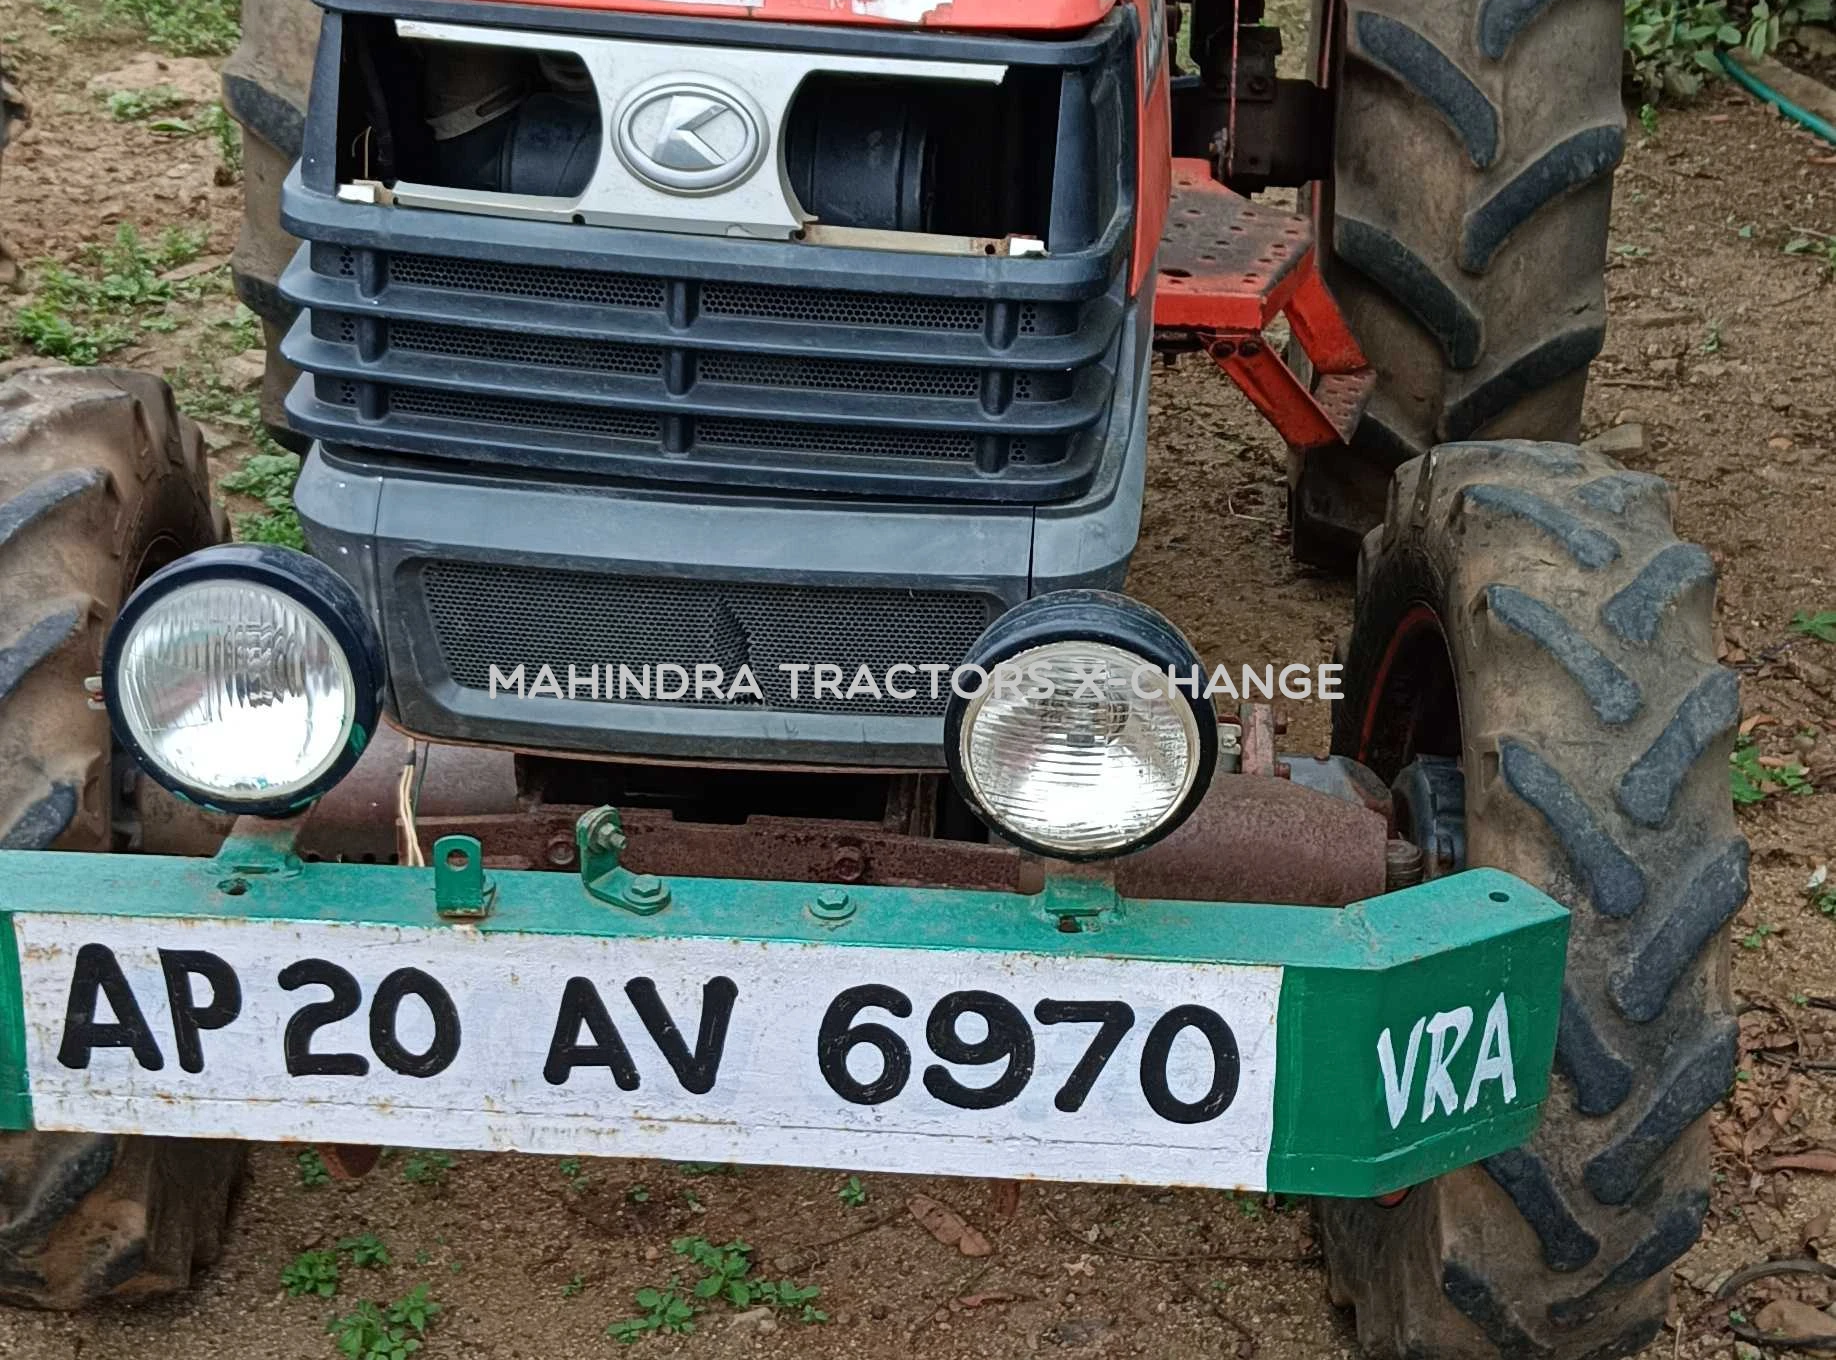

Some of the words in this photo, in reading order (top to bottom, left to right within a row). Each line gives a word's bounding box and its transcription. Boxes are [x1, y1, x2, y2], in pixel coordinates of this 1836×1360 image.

[57, 942, 243, 1074] AP
[277, 957, 463, 1078] 20
[542, 975, 740, 1096] AV
[816, 982, 1242, 1126] 6970
[1375, 991, 1518, 1131] VRA
